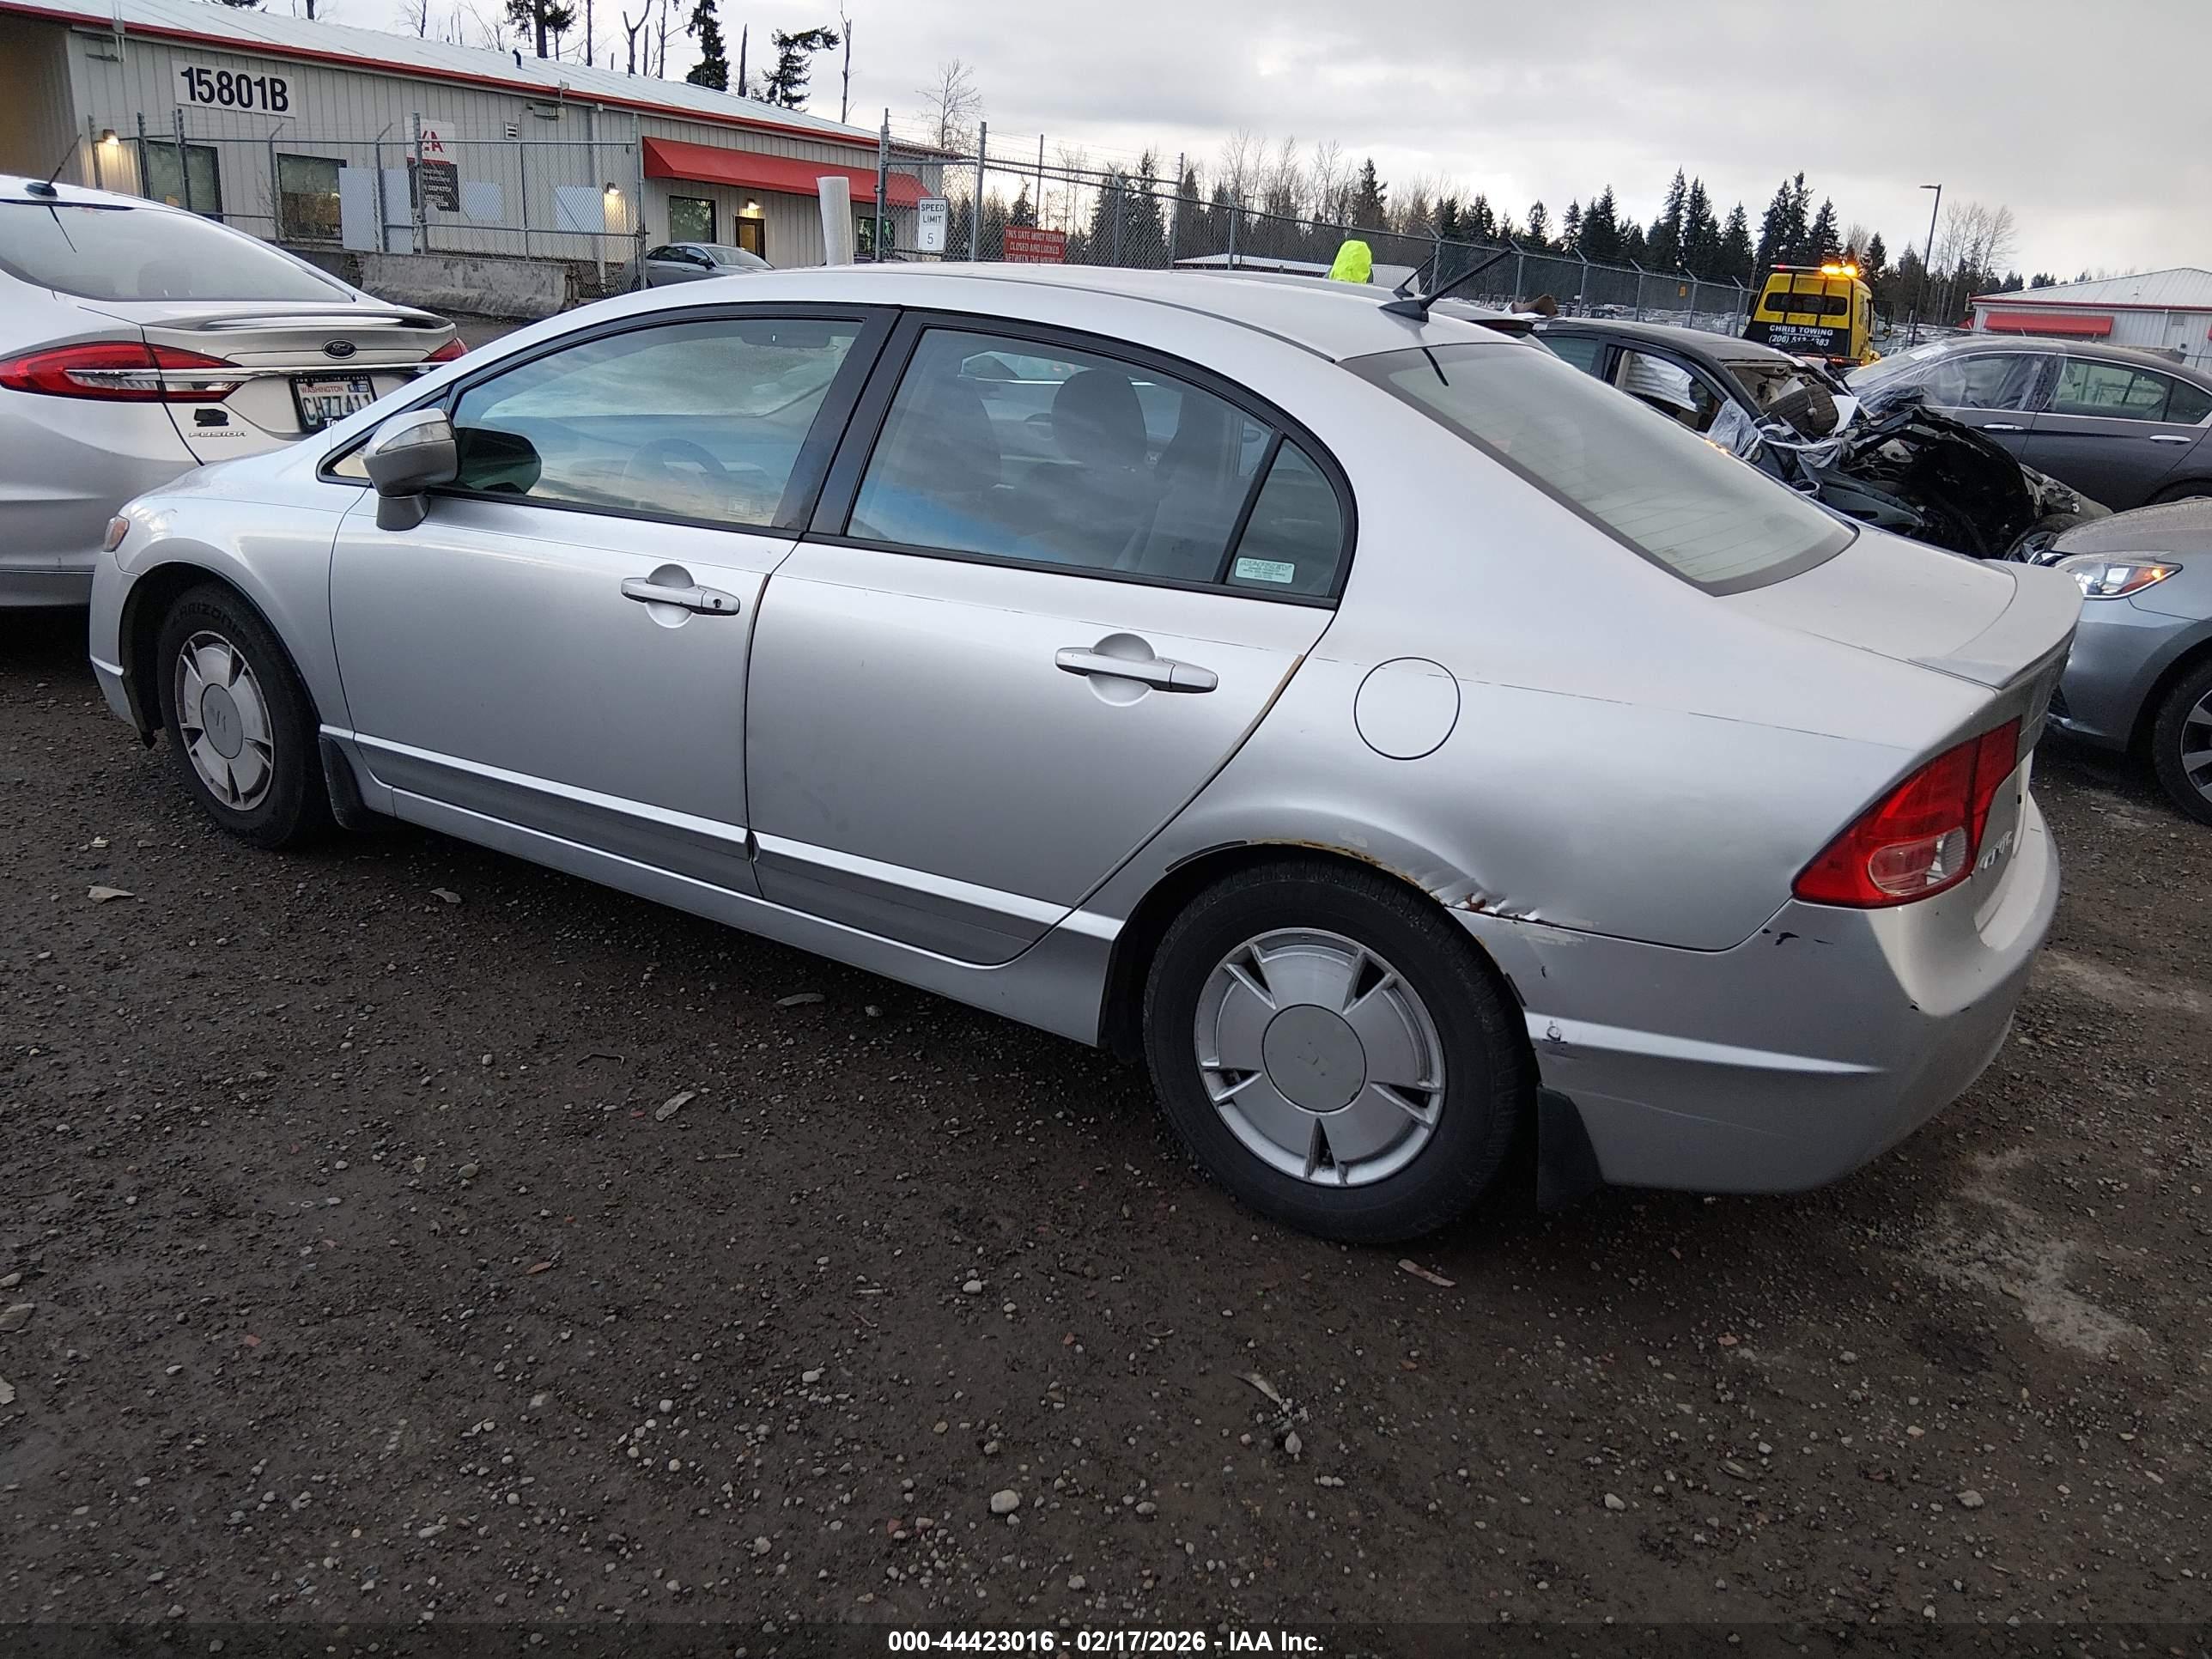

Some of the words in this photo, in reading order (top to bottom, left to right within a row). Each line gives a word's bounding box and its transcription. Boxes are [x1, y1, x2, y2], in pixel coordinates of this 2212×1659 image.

[180, 66, 289, 112] 15801B
[921, 204, 945, 212] SPEED
[923, 215, 942, 223] LIMIT
[927, 233, 933, 245] 5
[1005, 228, 1018, 239] THIS
[1018, 230, 1030, 240] GATE
[1031, 232, 1045, 241] MUST
[1046, 233, 1064, 243] REMAIN
[1010, 241, 1029, 252] CLOSED
[1030, 244, 1040, 253] AND
[1041, 245, 1059, 255] LOCKED
[1769, 325, 1796, 333] CHRIS
[1799, 326, 1833, 337] TOWING
[1769, 334, 1789, 344] (206)
